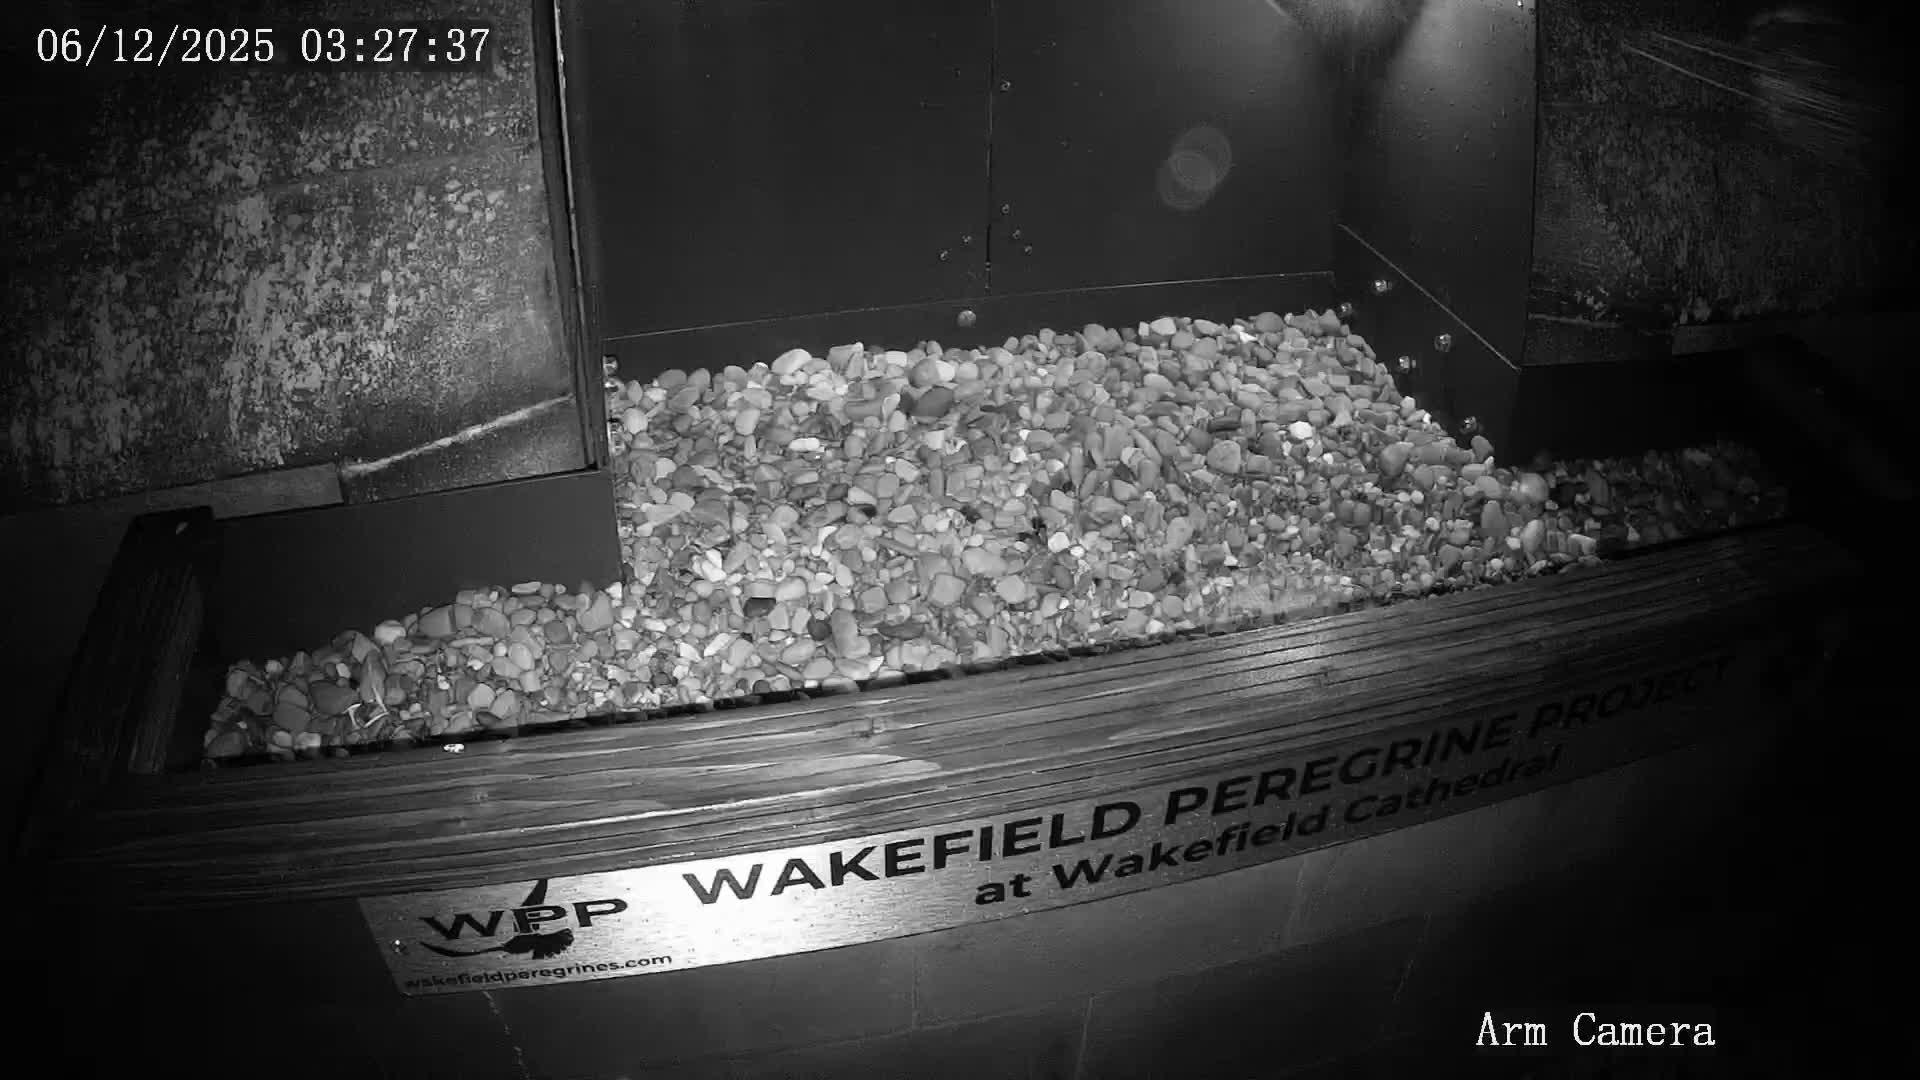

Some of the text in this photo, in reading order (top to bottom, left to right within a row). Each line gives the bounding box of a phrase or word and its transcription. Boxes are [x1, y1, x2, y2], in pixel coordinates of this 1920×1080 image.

[682, 655, 1736, 905] WAKEFIELD PEREGRINE PROJECT
[975, 743, 1562, 905] at Wakefield Cathedral
[417, 898, 628, 941] WPP
